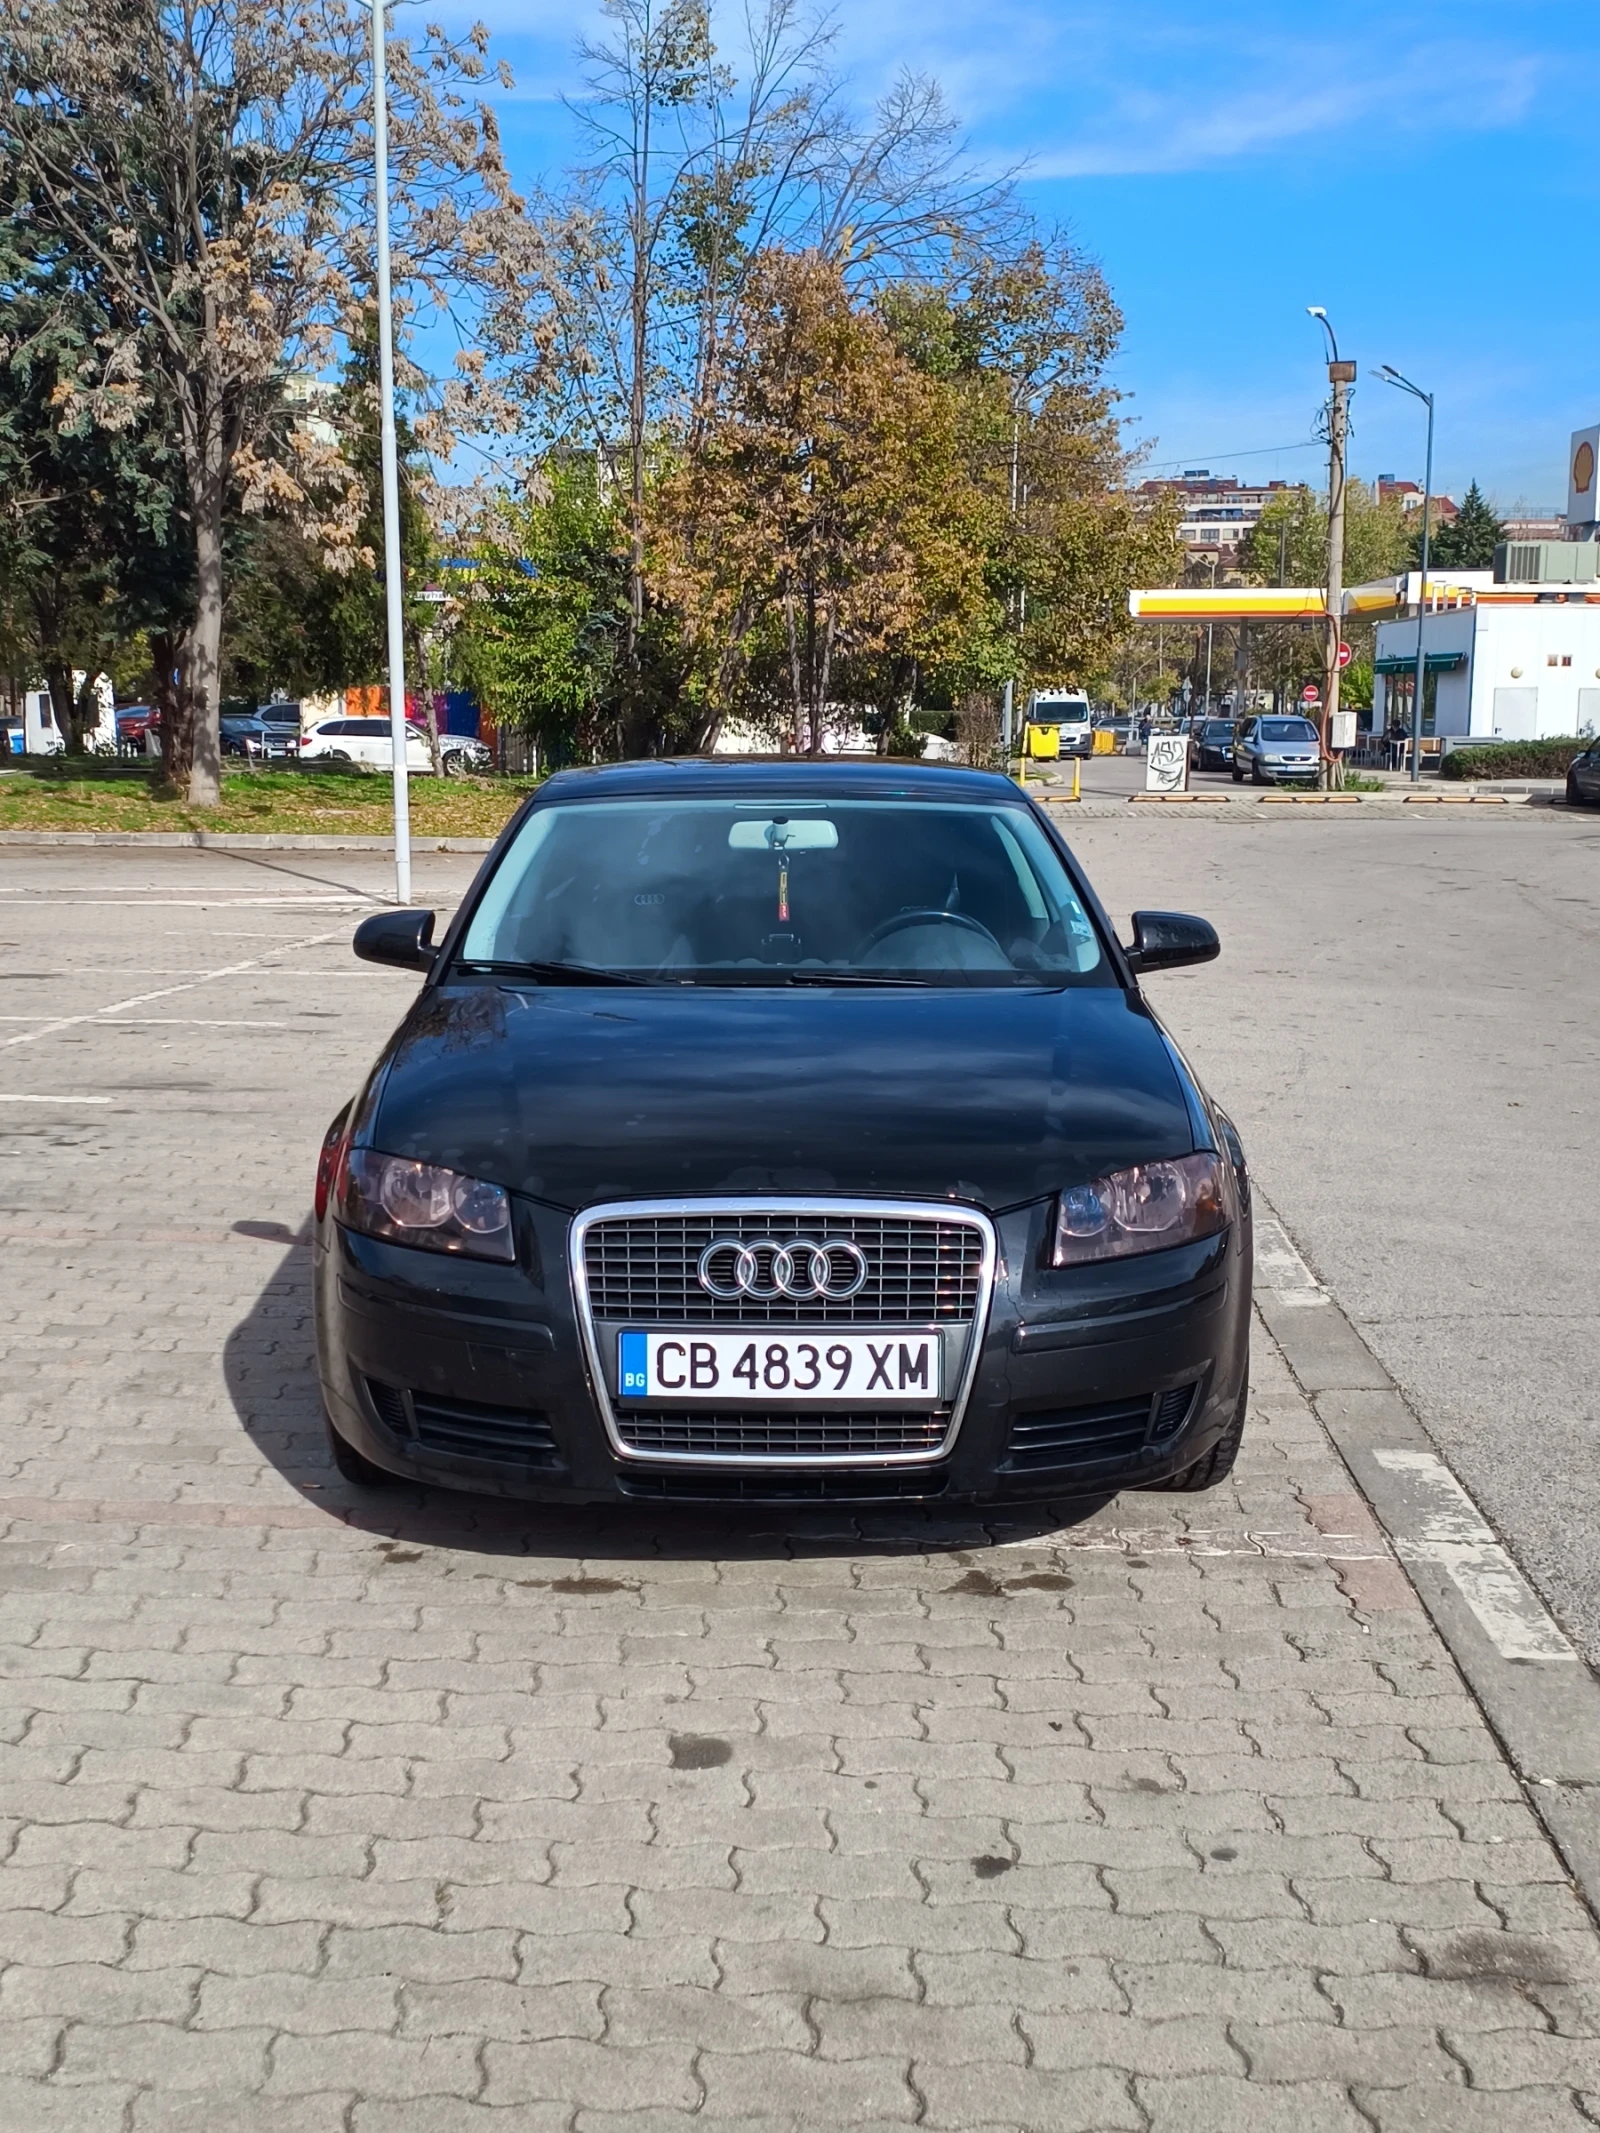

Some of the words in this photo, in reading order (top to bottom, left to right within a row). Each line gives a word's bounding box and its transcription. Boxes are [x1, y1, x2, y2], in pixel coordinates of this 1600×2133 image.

[625, 1372, 645, 1387] BG
[656, 1341, 720, 1389] CB
[732, 1343, 853, 1391] 4839
[866, 1343, 929, 1390] XM
